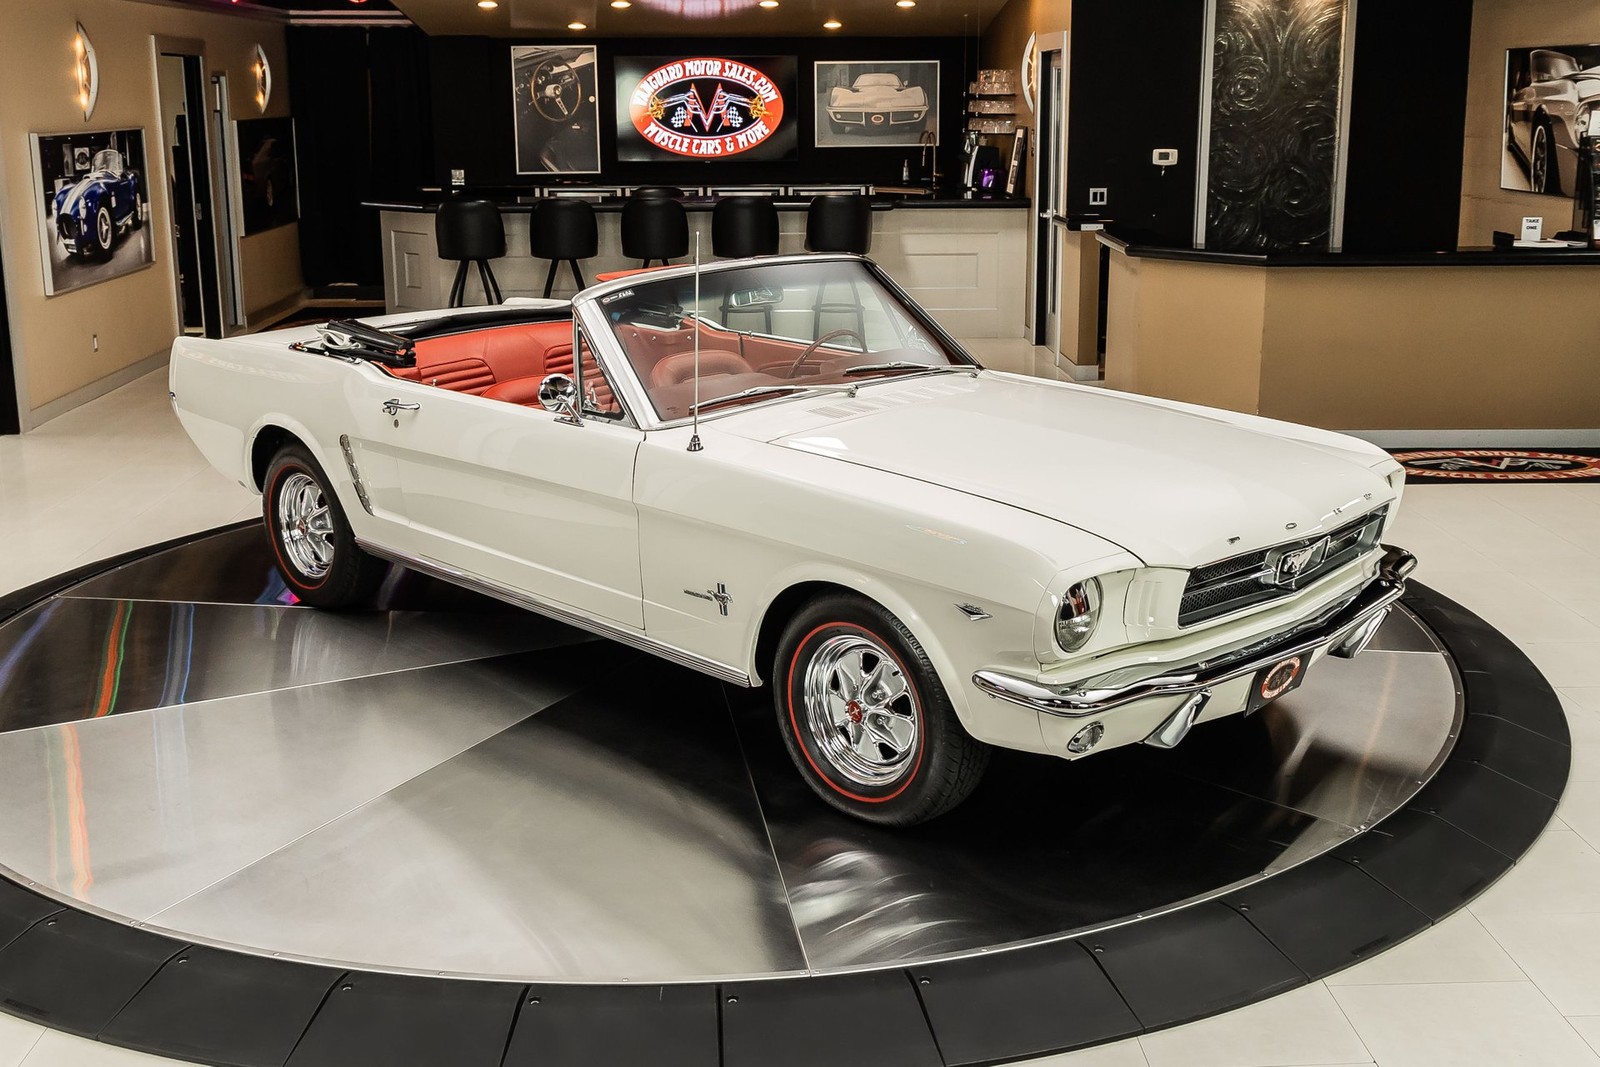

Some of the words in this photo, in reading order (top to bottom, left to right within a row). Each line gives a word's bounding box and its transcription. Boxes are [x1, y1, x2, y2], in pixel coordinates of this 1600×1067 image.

[633, 64, 684, 106] VANGUARD
[683, 60, 722, 77] MOTOR
[722, 61, 778, 103] SALES.COM
[643, 121, 690, 153] MUSCLE
[691, 139, 723, 155] CARS
[725, 137, 735, 152] &
[737, 121, 770, 149] MORE
